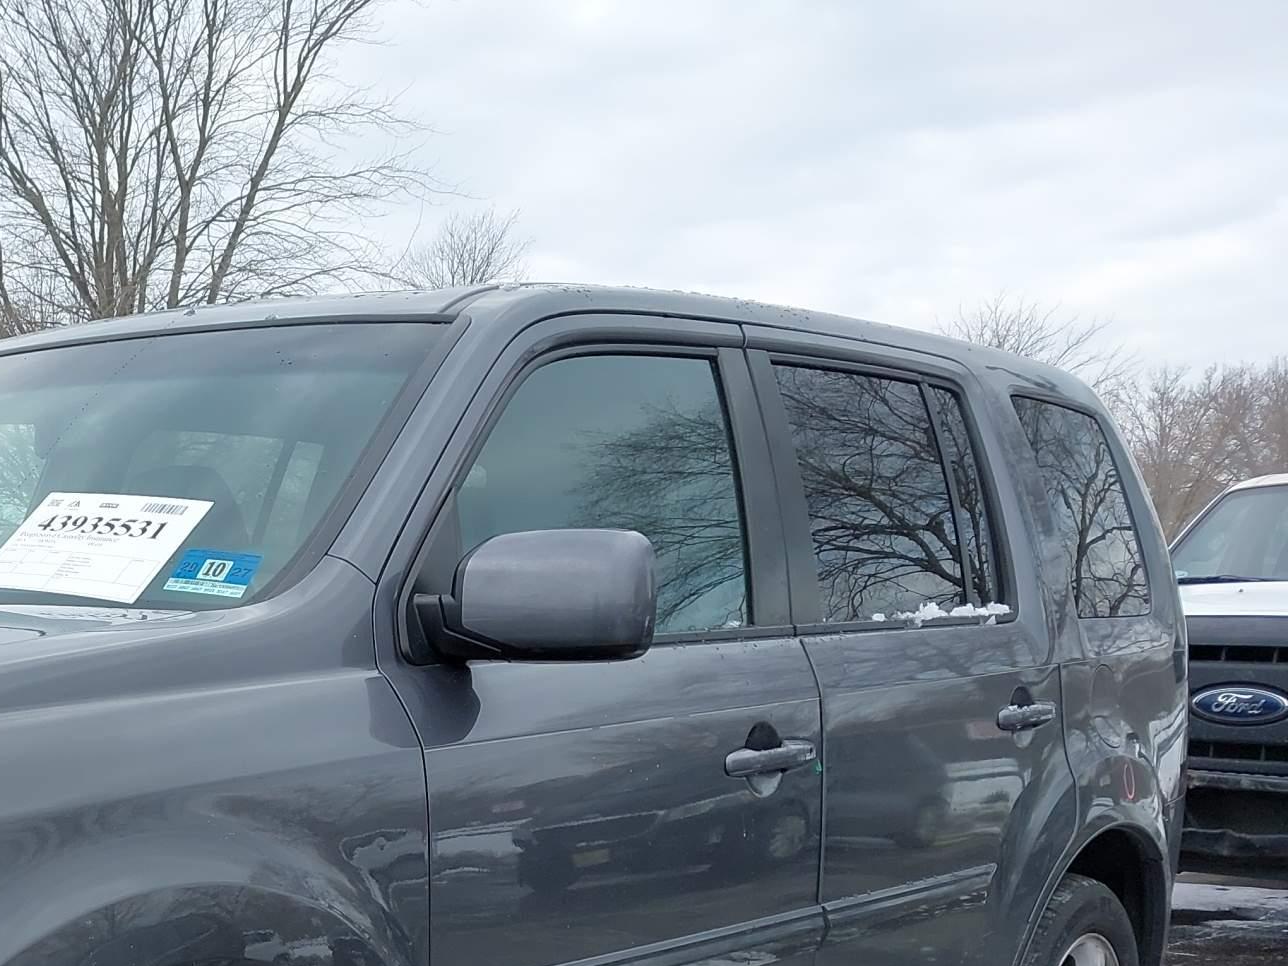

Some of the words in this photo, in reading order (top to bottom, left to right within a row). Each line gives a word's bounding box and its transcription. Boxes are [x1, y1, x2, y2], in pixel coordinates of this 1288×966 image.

[37, 513, 169, 541] 43935531
[202, 560, 227, 578] 10
[1211, 692, 1267, 715] Ford
